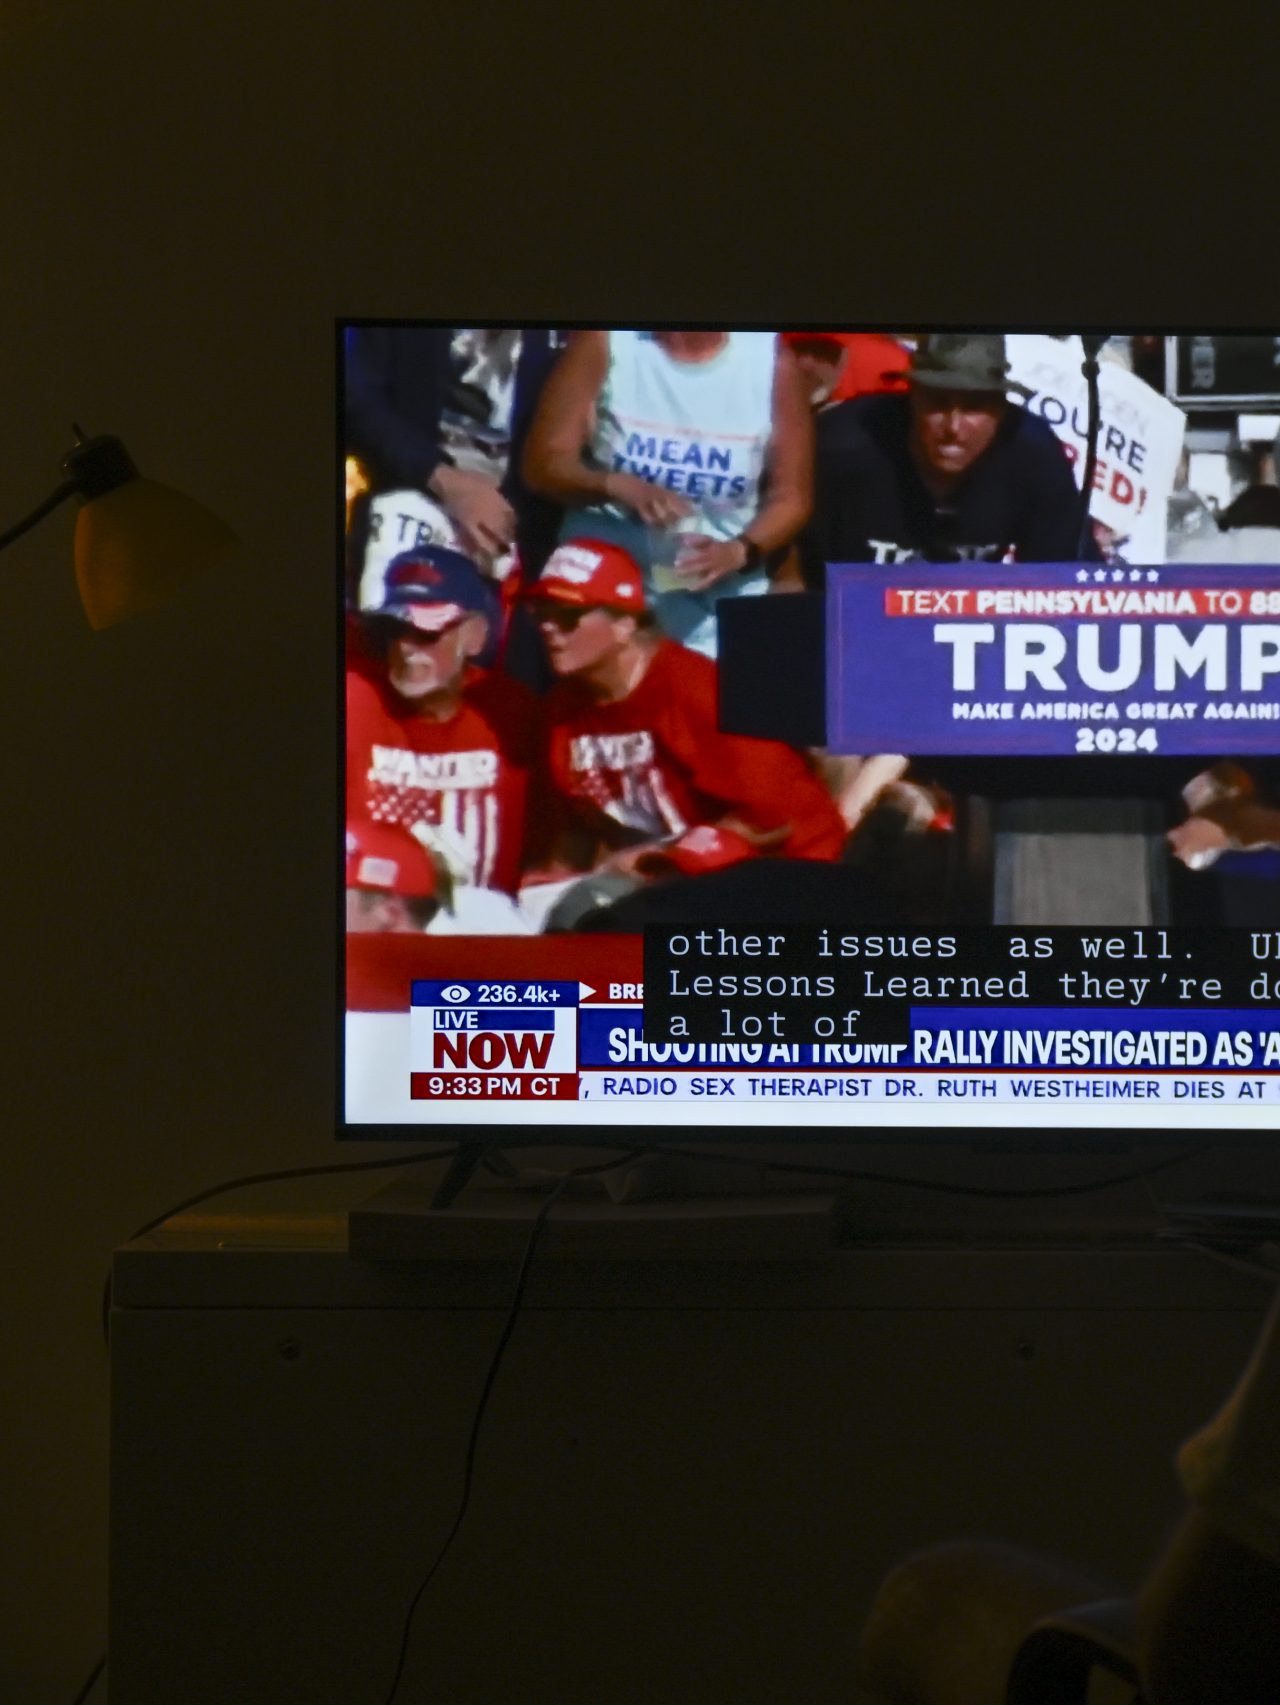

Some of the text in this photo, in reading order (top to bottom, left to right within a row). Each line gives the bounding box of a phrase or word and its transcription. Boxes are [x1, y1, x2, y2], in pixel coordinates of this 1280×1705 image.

[626, 432, 732, 472] MEAN
[613, 453, 746, 498] TWEETS
[897, 590, 969, 614] TEXT
[977, 590, 1197, 614] PENNSYLVANIA
[1204, 591, 1242, 614] TO
[953, 703, 1280, 719] MAKE AMERICA GREAT AGAIN!
[1075, 727, 1158, 752] 2024
[669, 929, 785, 956] other
[818, 930, 956, 957] issues
[1009, 937, 1054, 959] as
[1081, 931, 1193, 959] well.
[477, 985, 561, 1003] 236.4k+
[669, 970, 835, 997] Lessons
[864, 971, 1030, 998] Learned
[1058, 971, 1222, 1005] they're
[434, 1011, 479, 1029] LIVE
[669, 1009, 861, 1037] a lot of
[433, 1032, 555, 1070] NOW
[913, 1030, 998, 1064] RALLY
[1003, 1030, 1207, 1066] INVESTIGATED
[1212, 1031, 1253, 1067] AS
[429, 1077, 482, 1095] 9:33
[487, 1077, 522, 1095] PM
[530, 1077, 560, 1096] CT
[603, 1077, 677, 1096] RADIO
[690, 1078, 735, 1096] SEX
[748, 1078, 872, 1097] THERAPIST
[885, 1079, 923, 1097] DR.
[938, 1079, 997, 1098] RUTH
[1010, 1079, 1160, 1098] WESTHEIMER
[1174, 1080, 1225, 1099] DIES
[1238, 1081, 1266, 1099] AT
